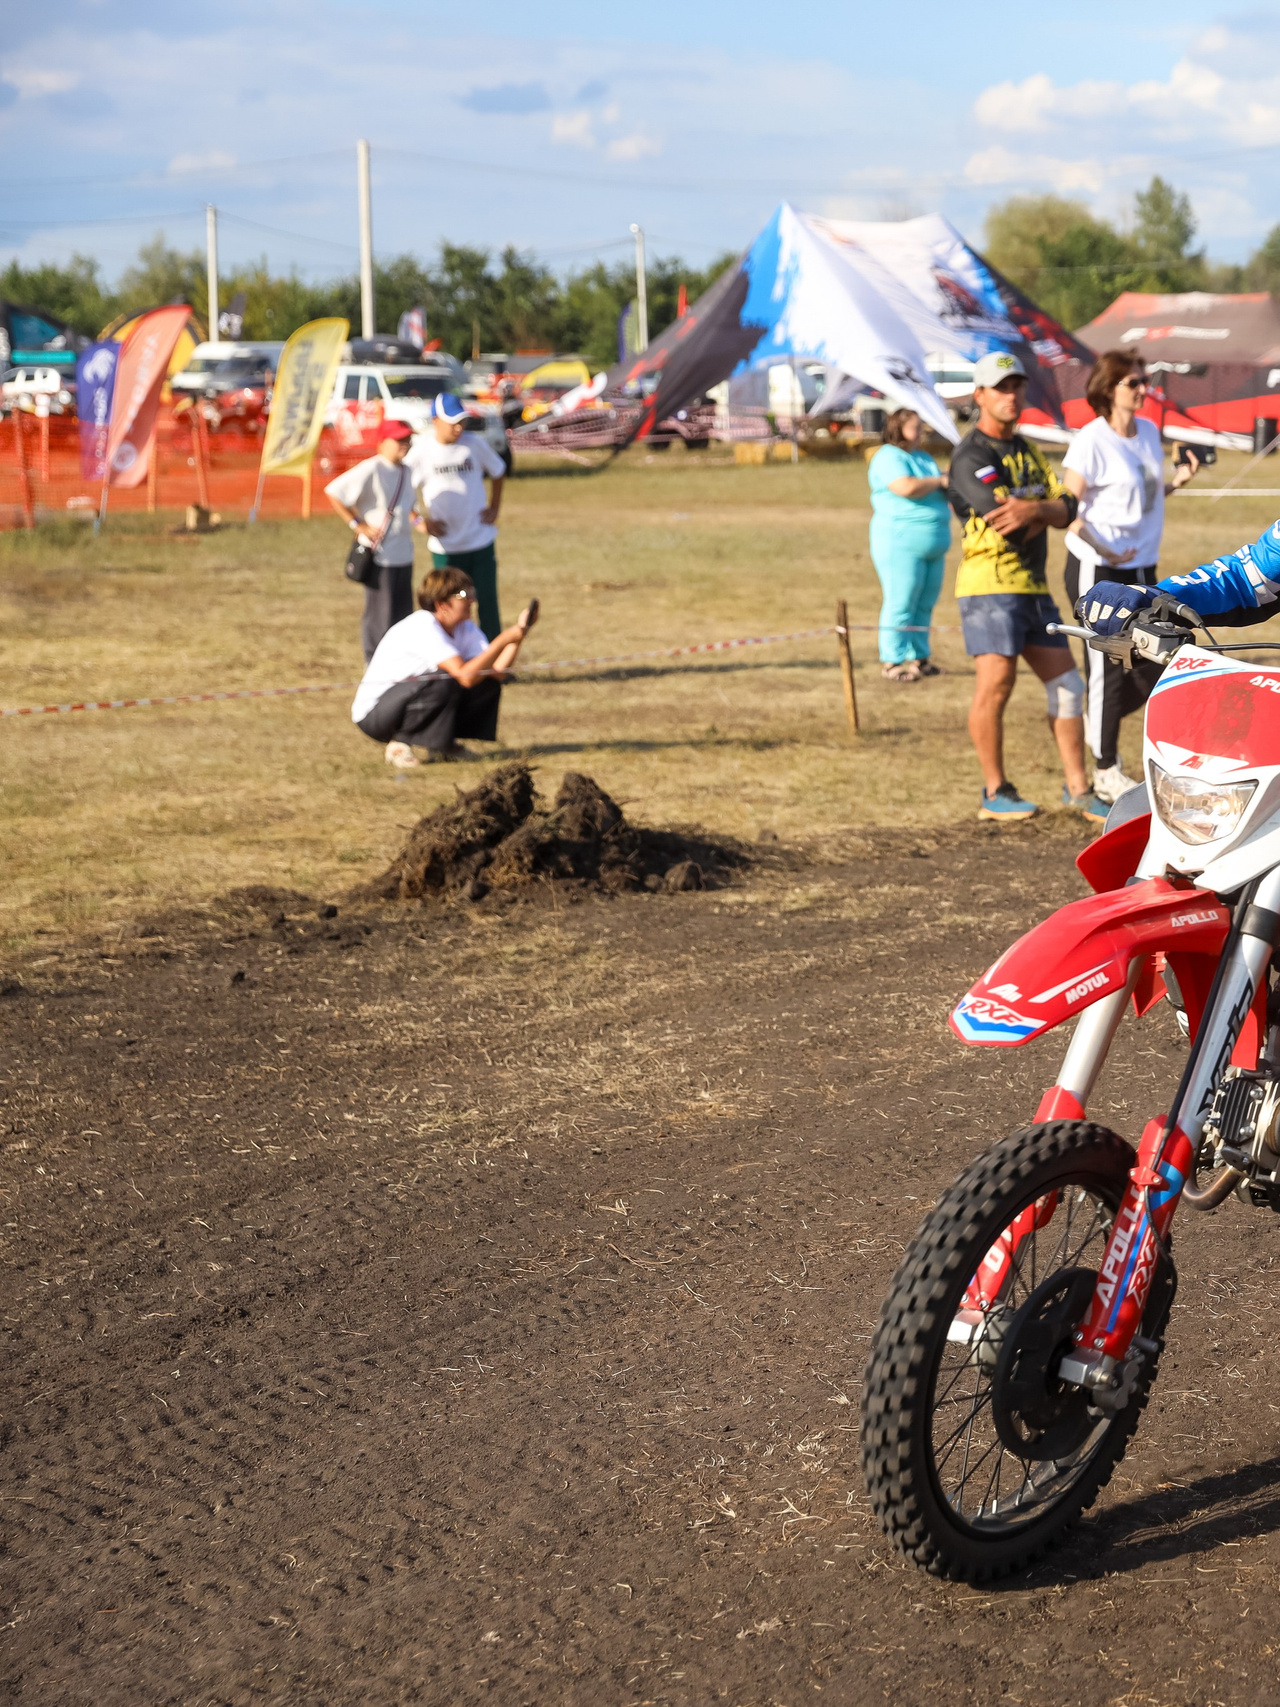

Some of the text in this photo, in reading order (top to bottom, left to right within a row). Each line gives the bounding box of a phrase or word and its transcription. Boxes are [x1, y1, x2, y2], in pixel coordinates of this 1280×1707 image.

[1169, 657, 1214, 671] RXF
[1171, 910, 1219, 928] APOLLO
[1064, 971, 1110, 1005] MOTUL
[965, 999, 1025, 1025] RXF
